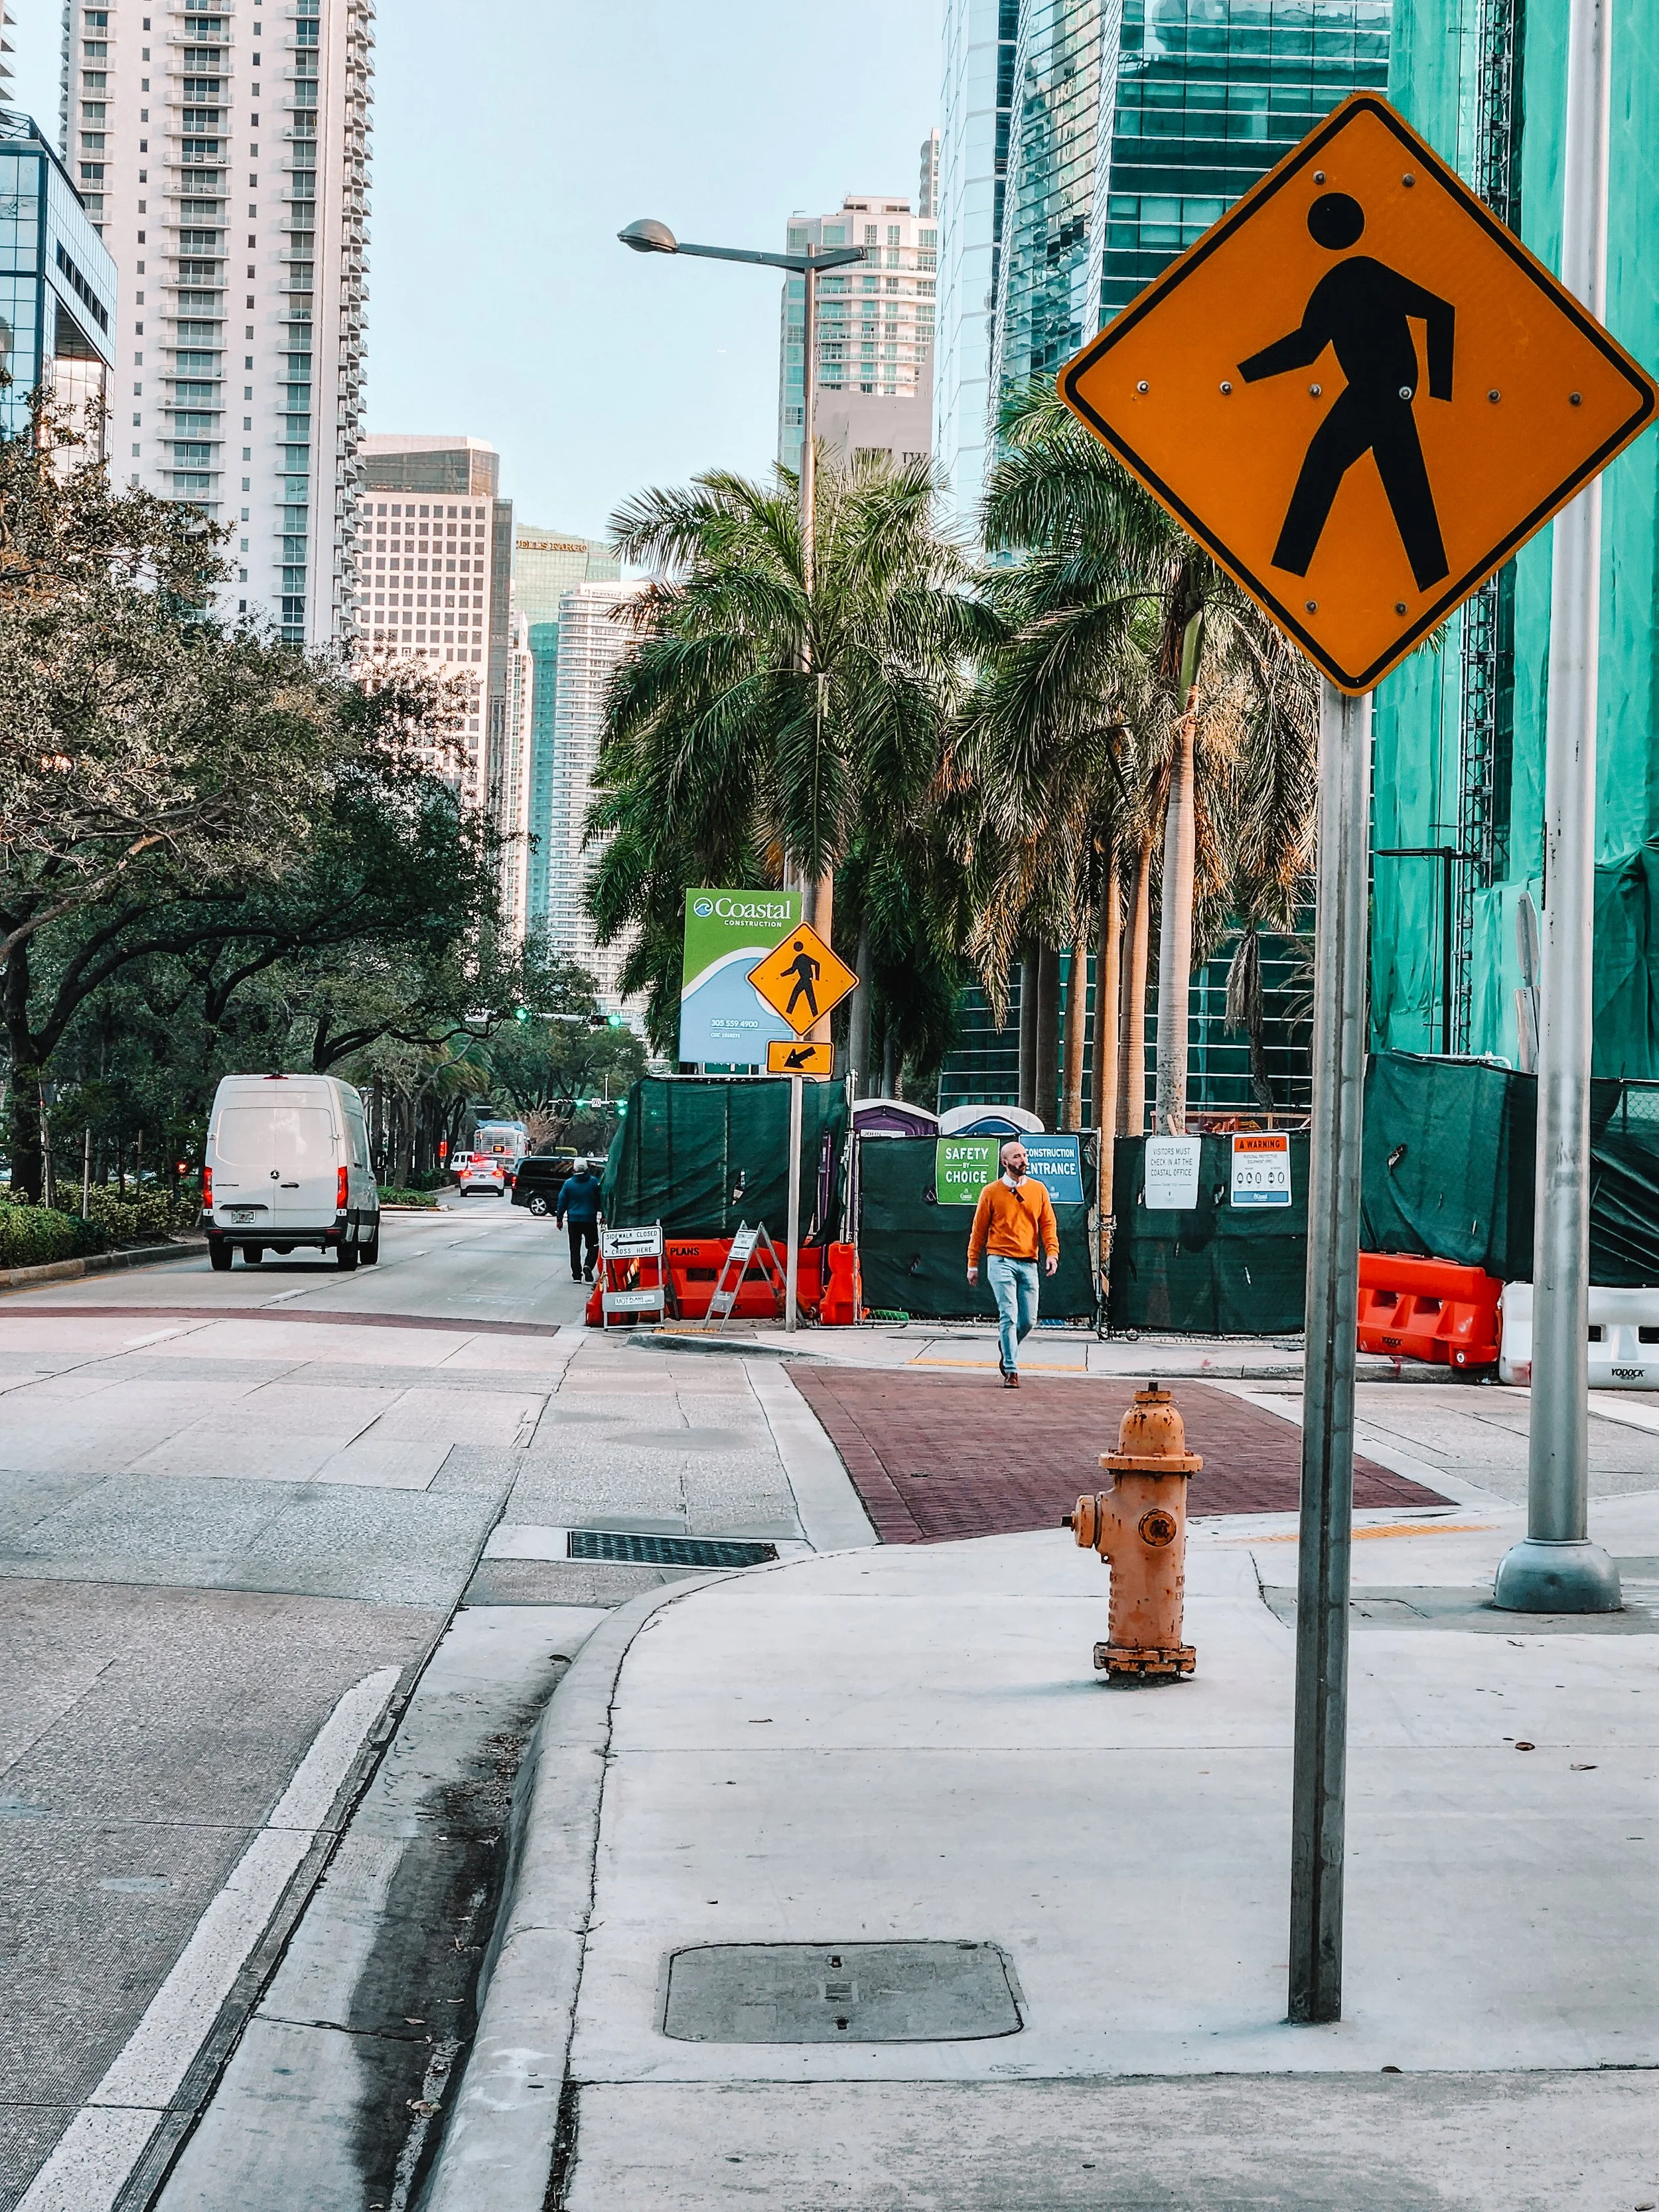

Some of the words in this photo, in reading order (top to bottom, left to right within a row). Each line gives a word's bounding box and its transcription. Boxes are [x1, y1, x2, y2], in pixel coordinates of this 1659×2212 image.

[516, 540, 549, 550] ELLS
[551, 542, 588, 553] FARGO
[715, 897, 791, 919] Coastal
[946, 1147, 989, 1160] SAFETY
[946, 1171, 987, 1183] CHOICE
[670, 1247, 700, 1256] PLANS
[1611, 1368, 1645, 1377] YODOCK
